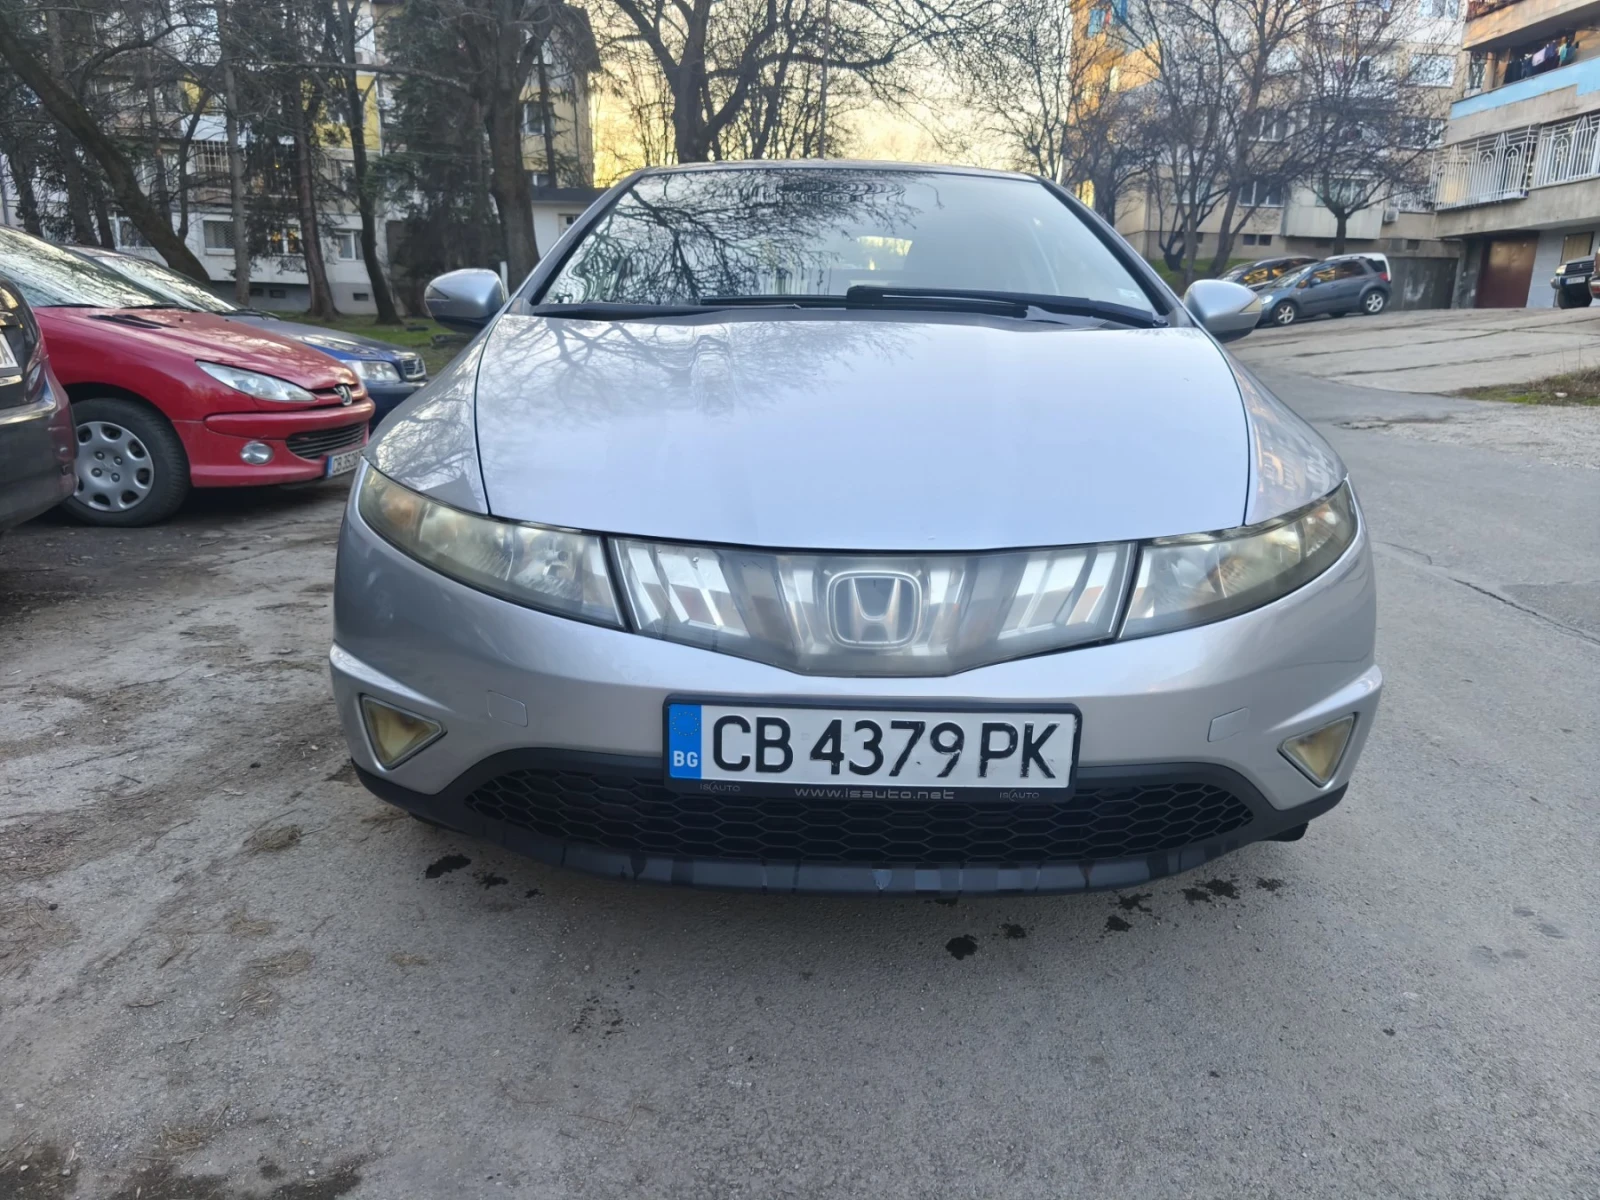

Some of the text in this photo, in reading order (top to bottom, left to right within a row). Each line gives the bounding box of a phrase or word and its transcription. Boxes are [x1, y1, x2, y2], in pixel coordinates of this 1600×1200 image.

[713, 715, 1060, 778] CB 4379 PK
[673, 751, 698, 767] BG
[795, 788, 954, 799] www.isauto.net
